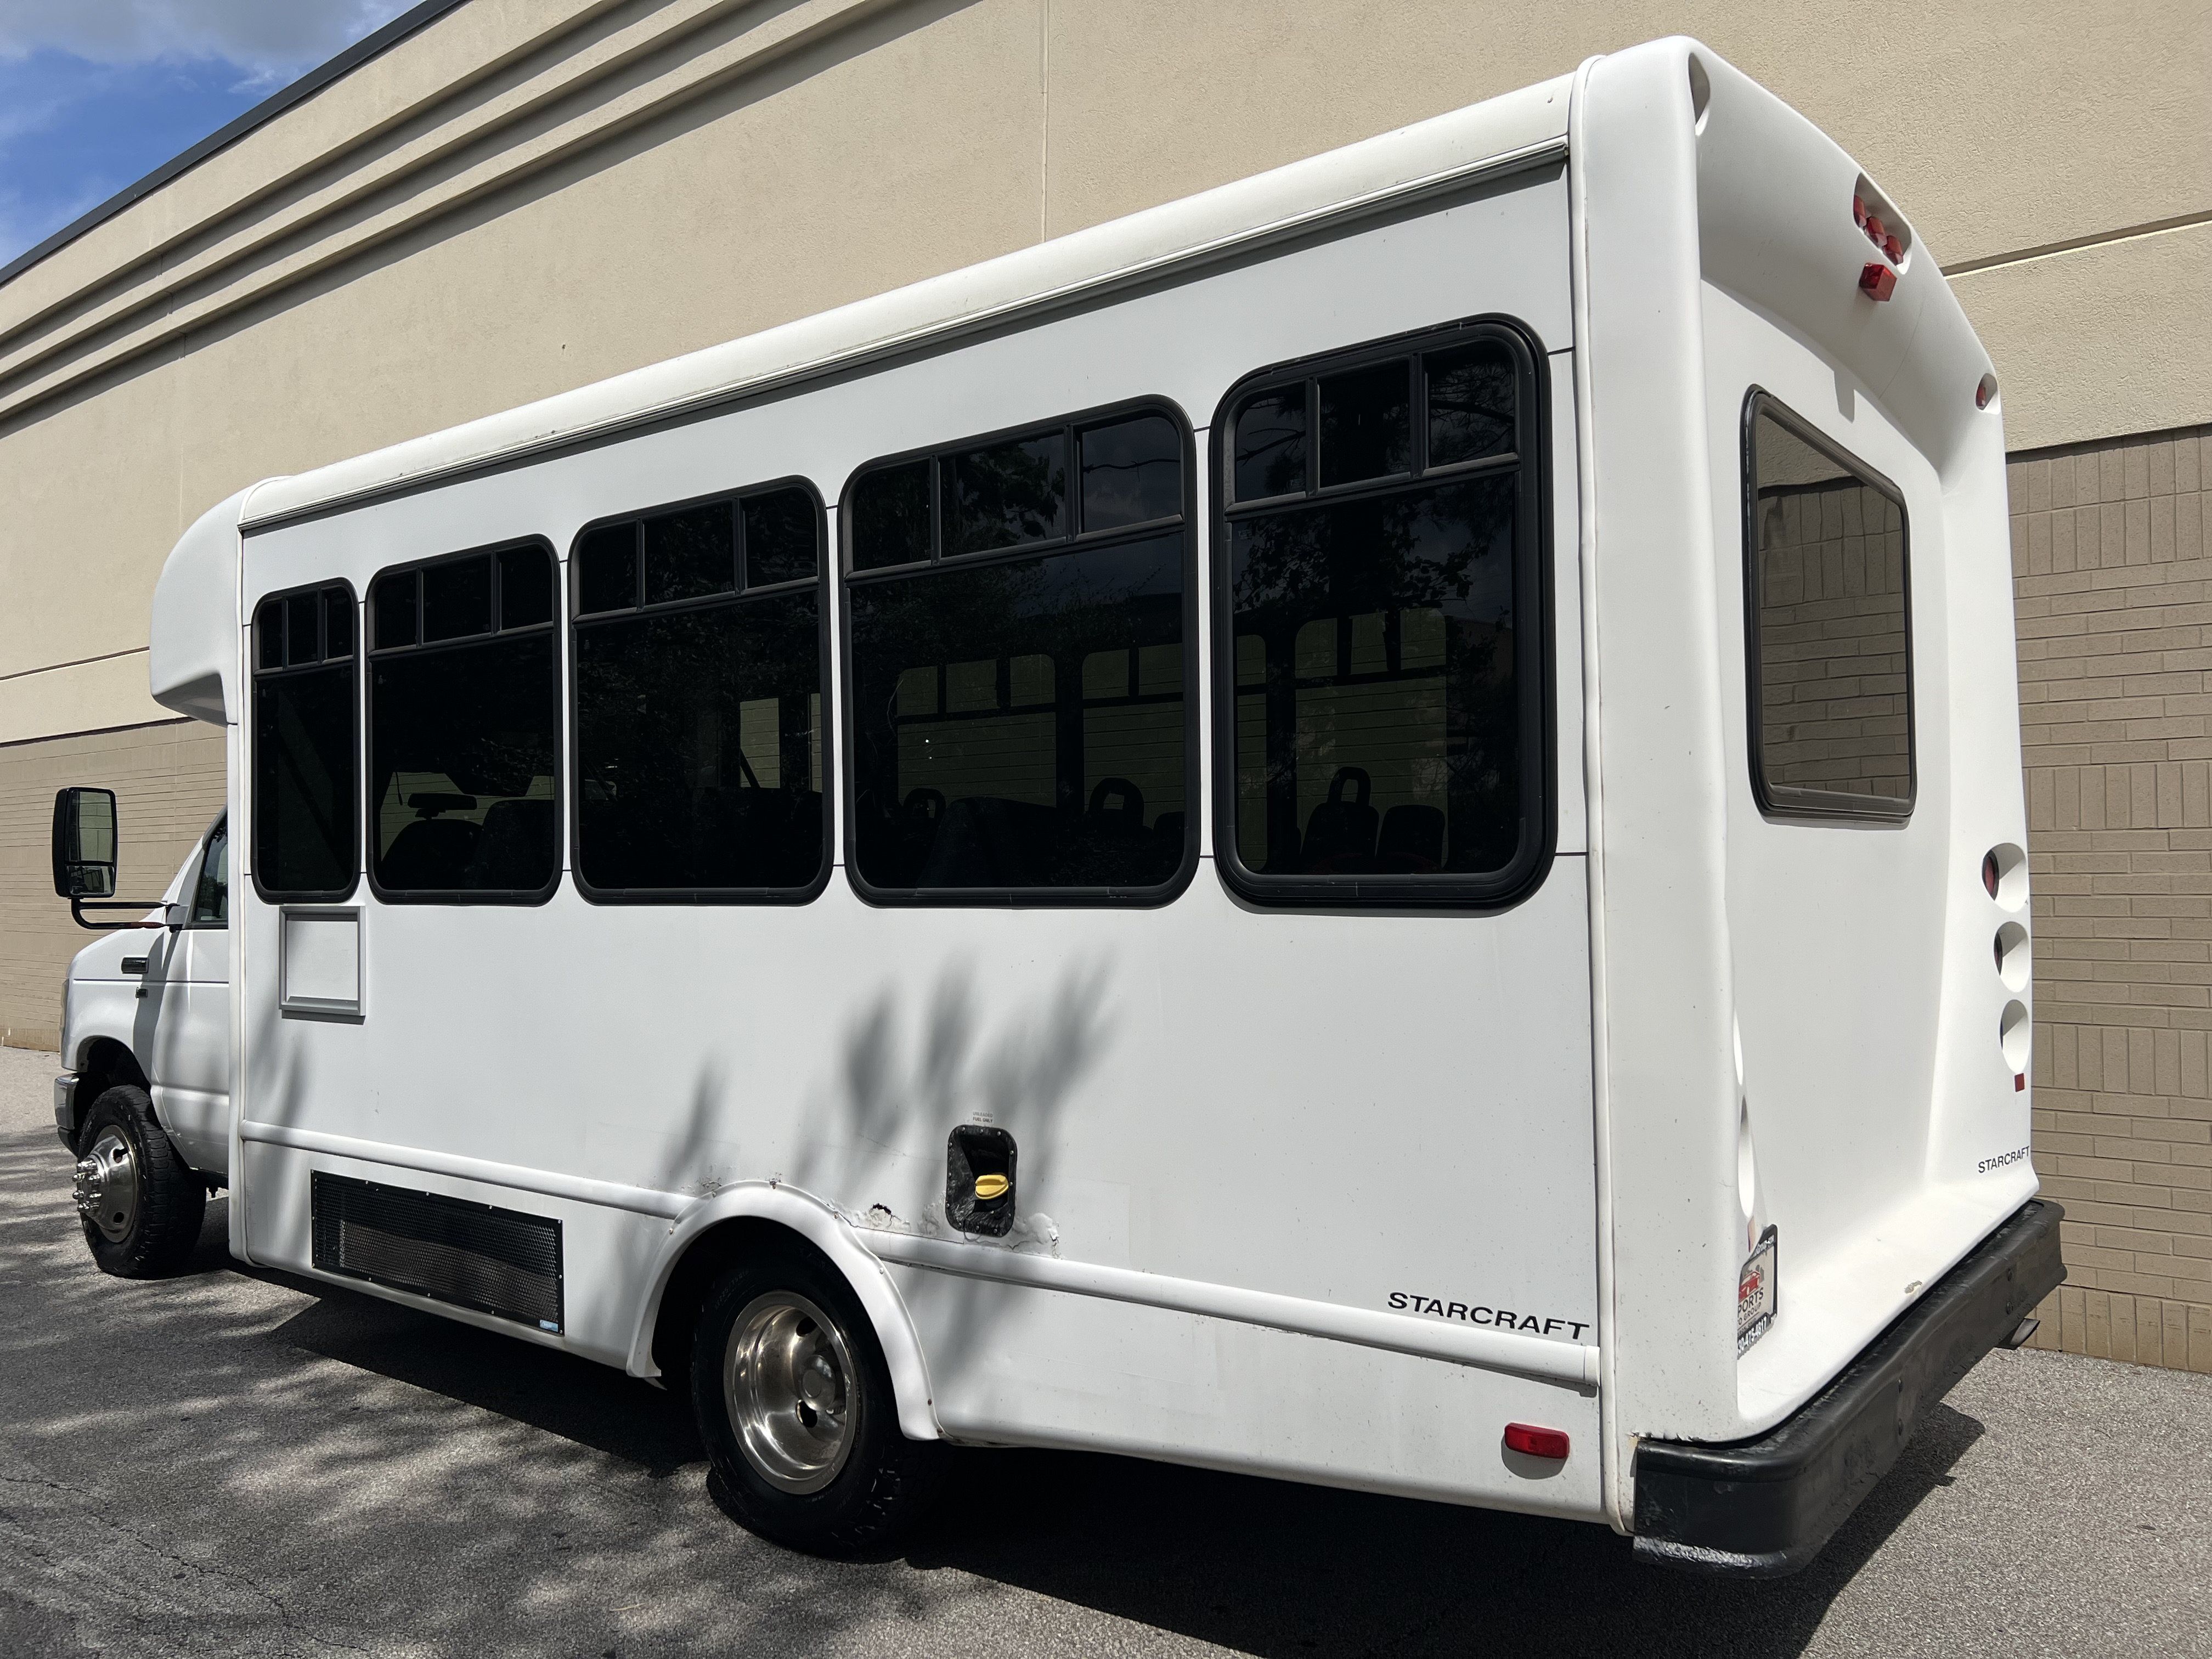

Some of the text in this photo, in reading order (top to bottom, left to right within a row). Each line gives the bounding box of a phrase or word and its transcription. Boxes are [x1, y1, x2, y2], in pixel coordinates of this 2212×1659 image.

[1978, 1145, 2029, 1173] STARCRAFT
[1387, 1291, 1590, 1340] STARCRAFT
[1744, 1302, 1762, 1321] GROUP
